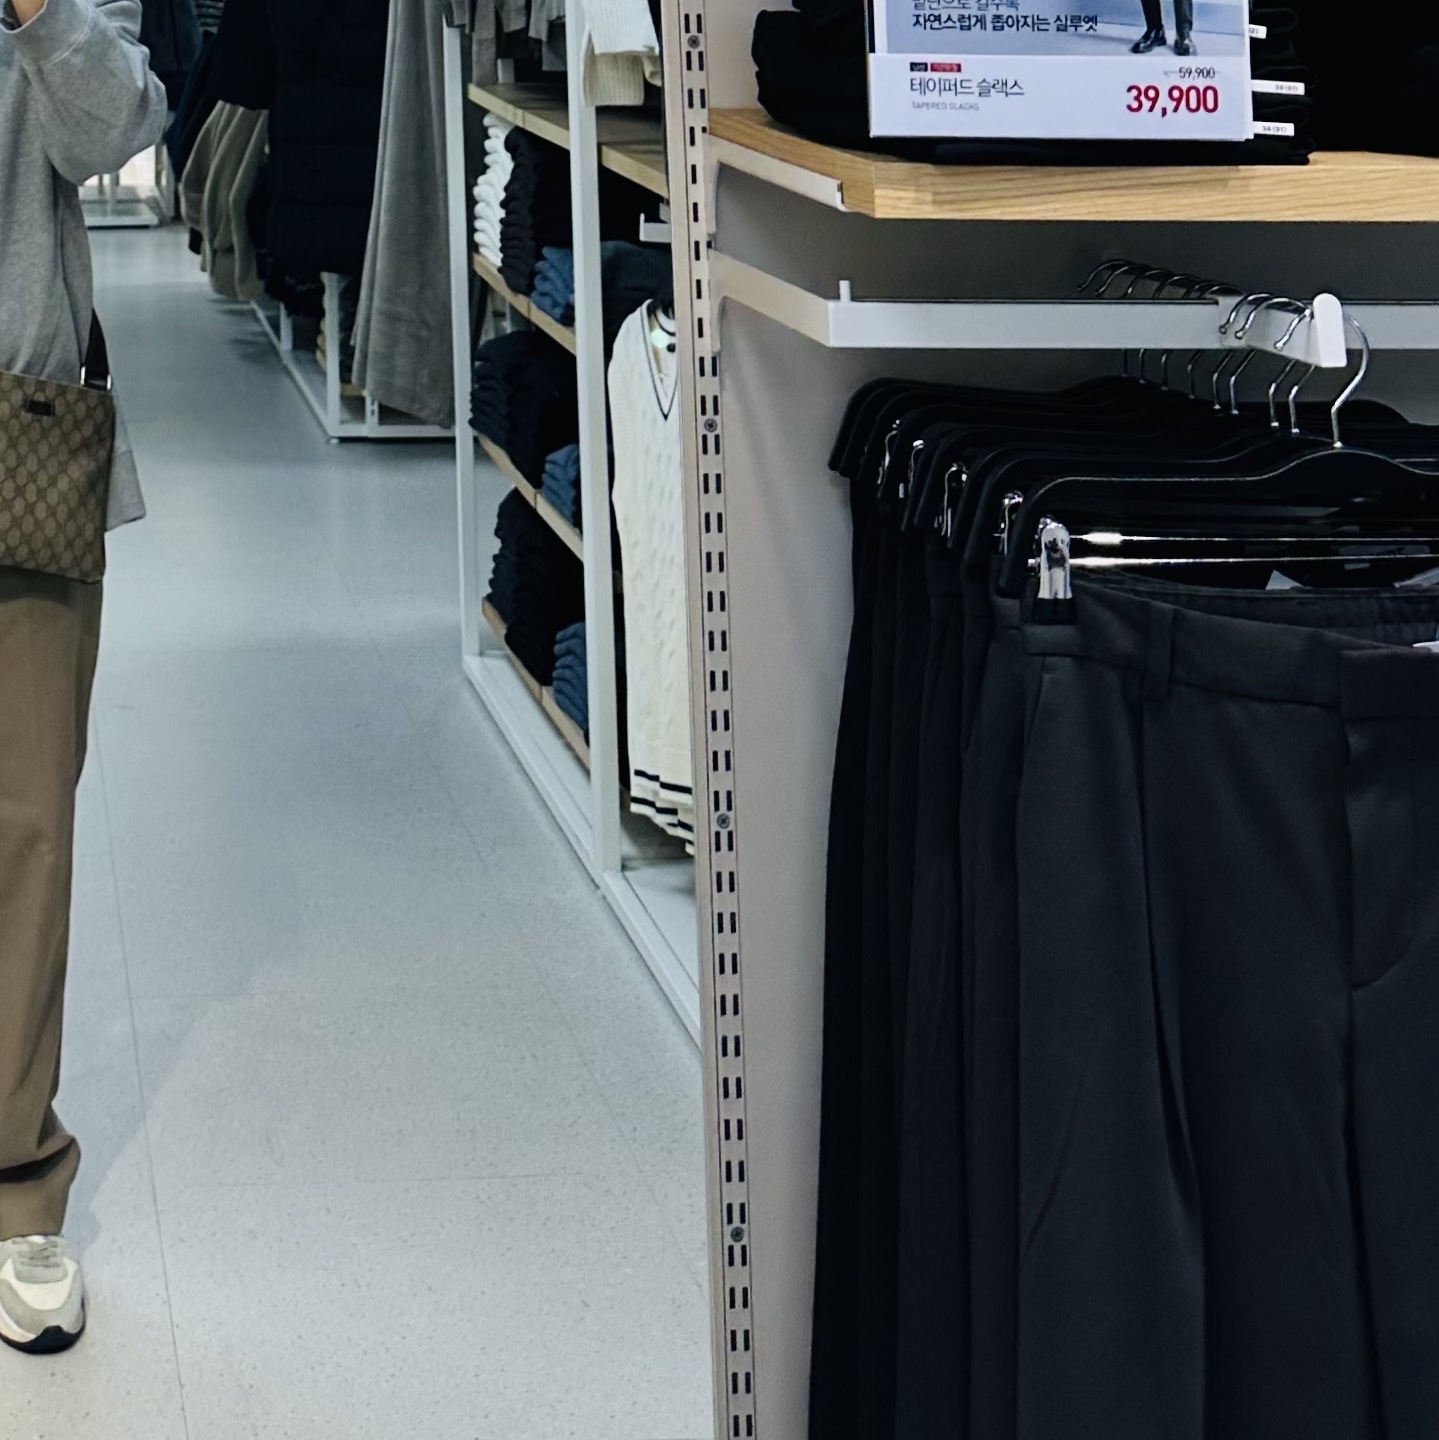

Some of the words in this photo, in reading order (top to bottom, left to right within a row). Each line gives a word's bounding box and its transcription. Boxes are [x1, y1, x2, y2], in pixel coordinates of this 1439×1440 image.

[911, 13, 987, 31] 자연스럽게
[990, 13, 1052, 33] 좁아지는
[1053, 14, 1099, 34] 실루엣
[1178, 66, 1217, 81] 59,900
[909, 76, 975, 97] 테이퍼드
[976, 77, 1026, 98] 슬랙스
[911, 100, 948, 111] TAPERED
[1125, 84, 1220, 119] 39,900
